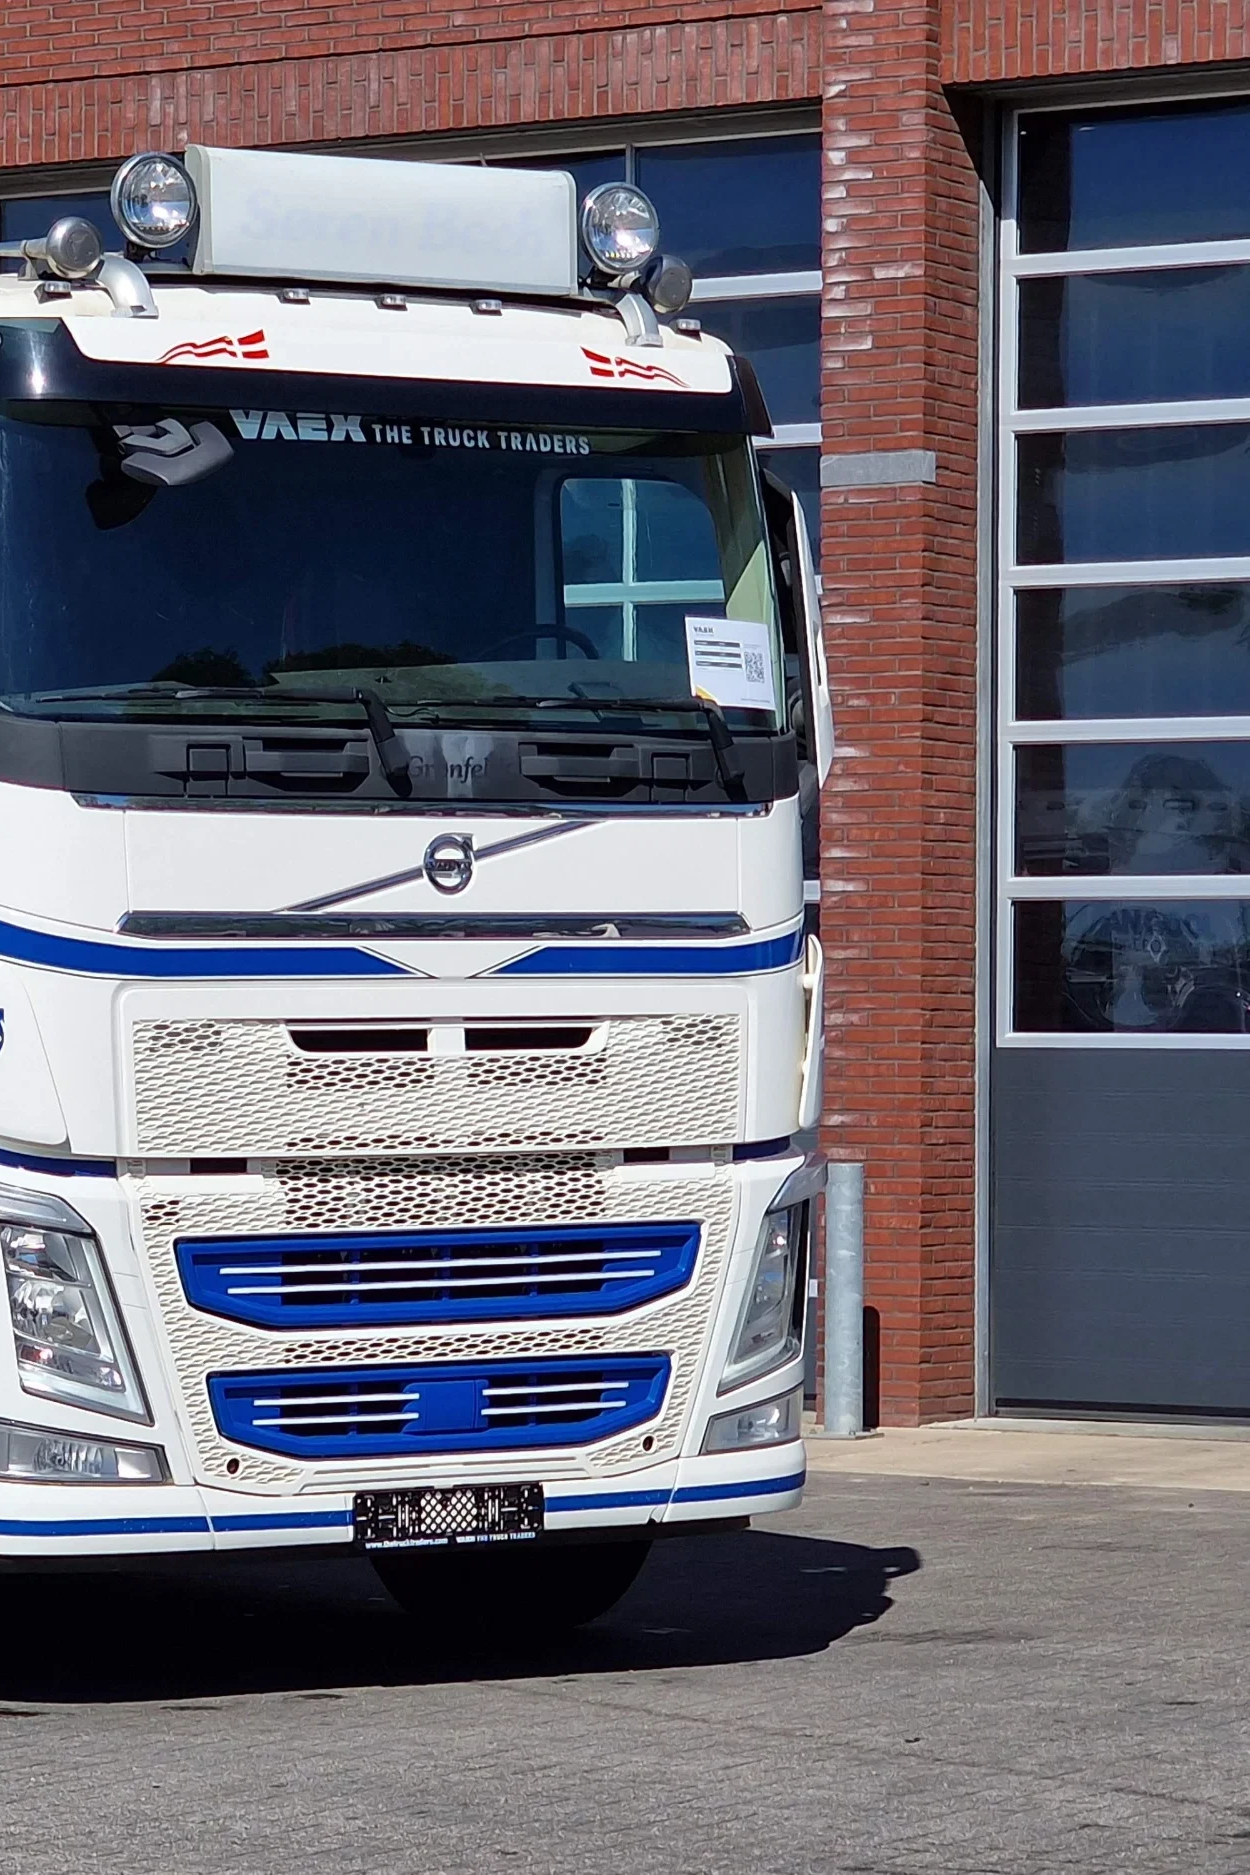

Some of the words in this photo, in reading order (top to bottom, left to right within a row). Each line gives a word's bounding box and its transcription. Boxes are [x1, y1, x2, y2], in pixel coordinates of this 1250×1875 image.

[229, 409, 367, 443] VAEX
[373, 425, 413, 445] THE
[420, 427, 491, 449] TRUCK
[497, 431, 591, 456] TRADERS
